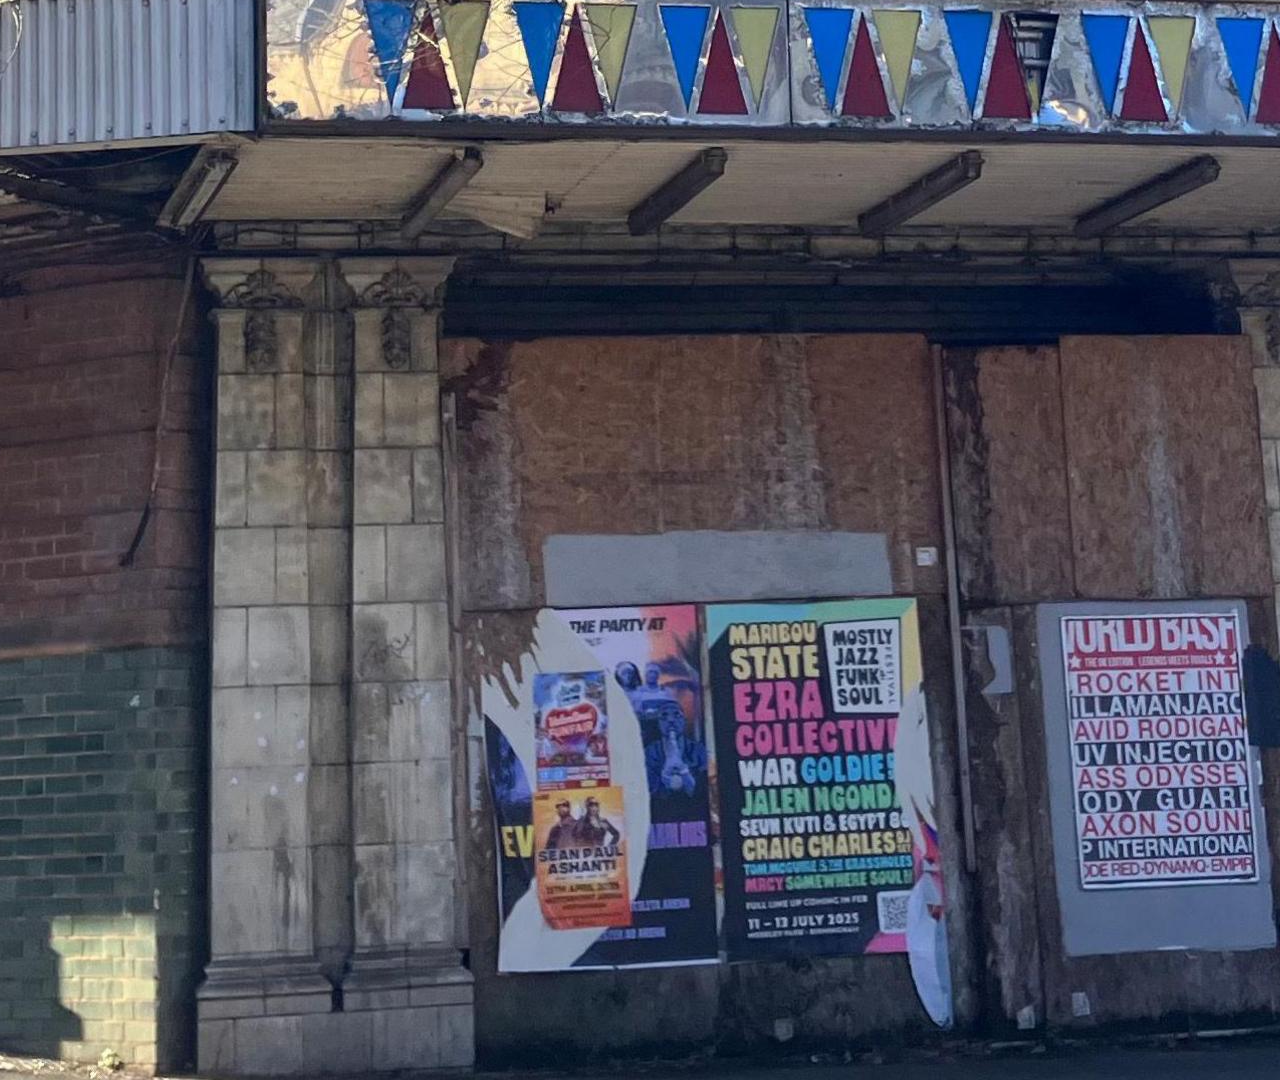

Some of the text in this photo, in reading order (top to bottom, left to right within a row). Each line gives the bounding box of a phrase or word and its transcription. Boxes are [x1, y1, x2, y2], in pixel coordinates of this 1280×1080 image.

[569, 617, 667, 633] THE PARTY AT
[729, 622, 816, 646] MARIBOU
[833, 629, 893, 646] MOSTLY
[730, 645, 820, 680] STATE
[835, 647, 879, 666] JAZZ
[837, 669, 880, 686] FUNK
[885, 647, 897, 705] FESTIVAL
[1077, 670, 1185, 693] ROCKET
[733, 680, 824, 722] EZRA
[839, 688, 883, 706] SOUL
[1074, 719, 1128, 741] AVID
[1075, 744, 1107, 766] UV
[738, 758, 798, 787] WAR
[800, 754, 885, 784] GOLDIE
[1078, 763, 1248, 789] ASS ODYSSEY
[741, 786, 811, 816] JALEN
[1082, 790, 1142, 813] ODY
[739, 818, 781, 836] SEUN
[783, 816, 820, 834] KUTI
[823, 814, 836, 831] &
[839, 813, 885, 832] EGYPT
[1082, 813, 1156, 837] AXON
[538, 846, 624, 863] SEAN PAUL
[742, 831, 895, 861] CRAIG CHARLES
[548, 860, 616, 875] ASHANTI
[786, 872, 868, 890] SOMEWHERE
[746, 902, 766, 910] FULL
[768, 901, 789, 909] LINE
[789, 899, 802, 908] UP
[803, 897, 839, 907] COMING
[852, 895, 868, 903] FEB
[748, 918, 760, 930] 11
[791, 914, 825, 928] JULY
[827, 912, 859, 926] 2025
